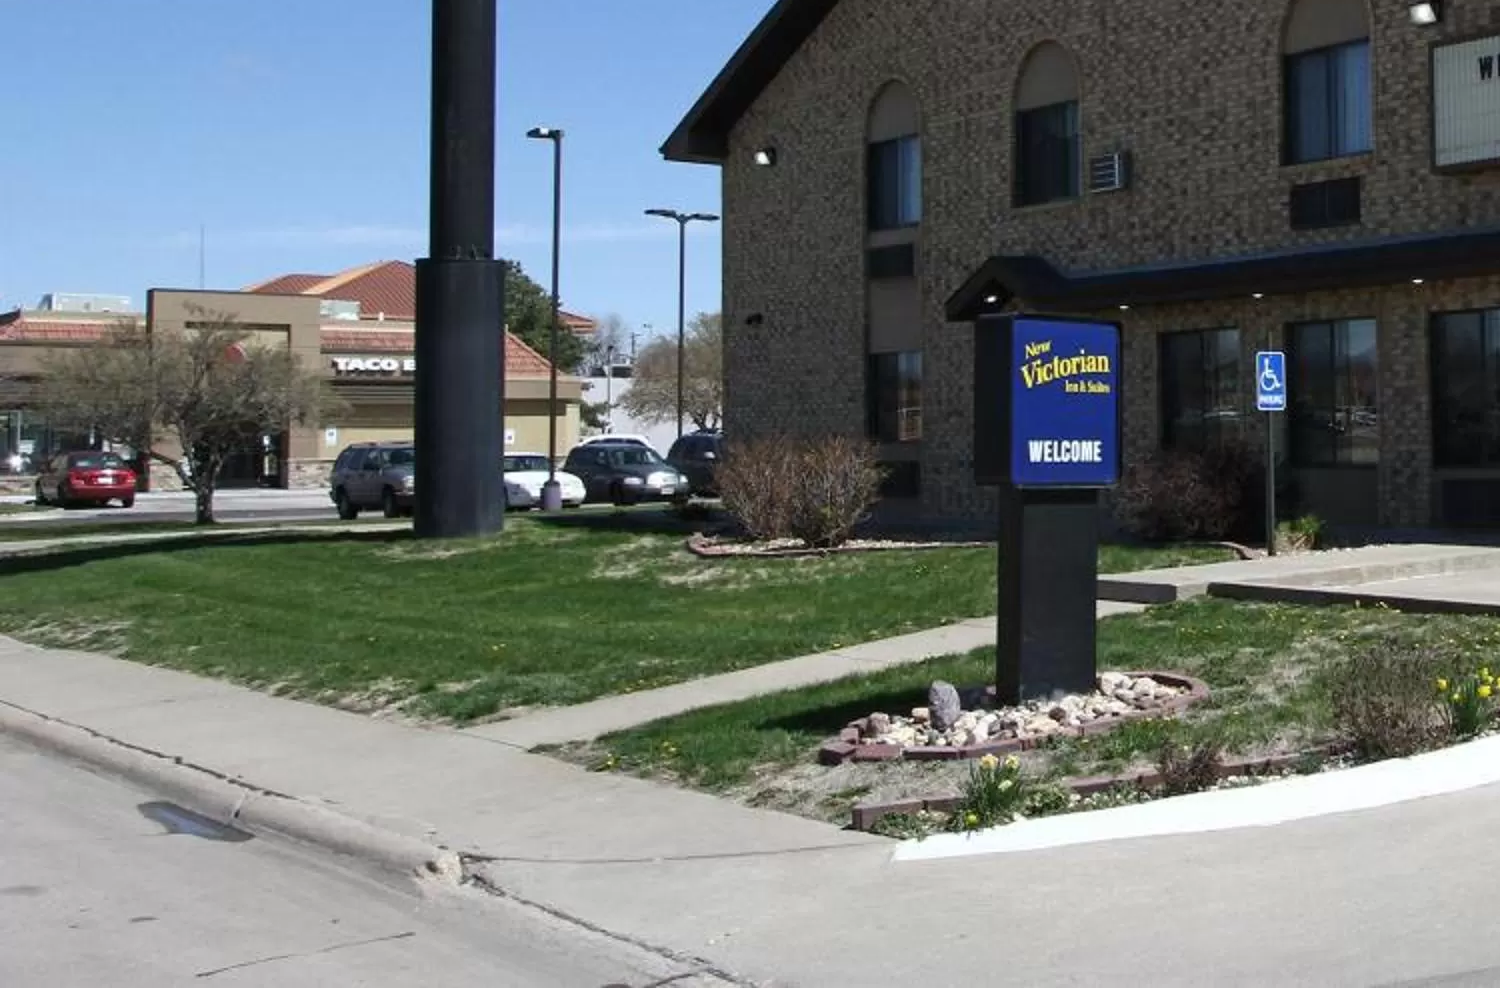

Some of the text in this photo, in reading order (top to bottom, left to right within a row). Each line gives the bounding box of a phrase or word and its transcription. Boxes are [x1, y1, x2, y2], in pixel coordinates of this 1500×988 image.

[1025, 339, 1052, 360] New
[333, 357, 400, 372] TACO
[1021, 348, 1111, 389] Victorian
[1028, 439, 1103, 463] WELCOME
